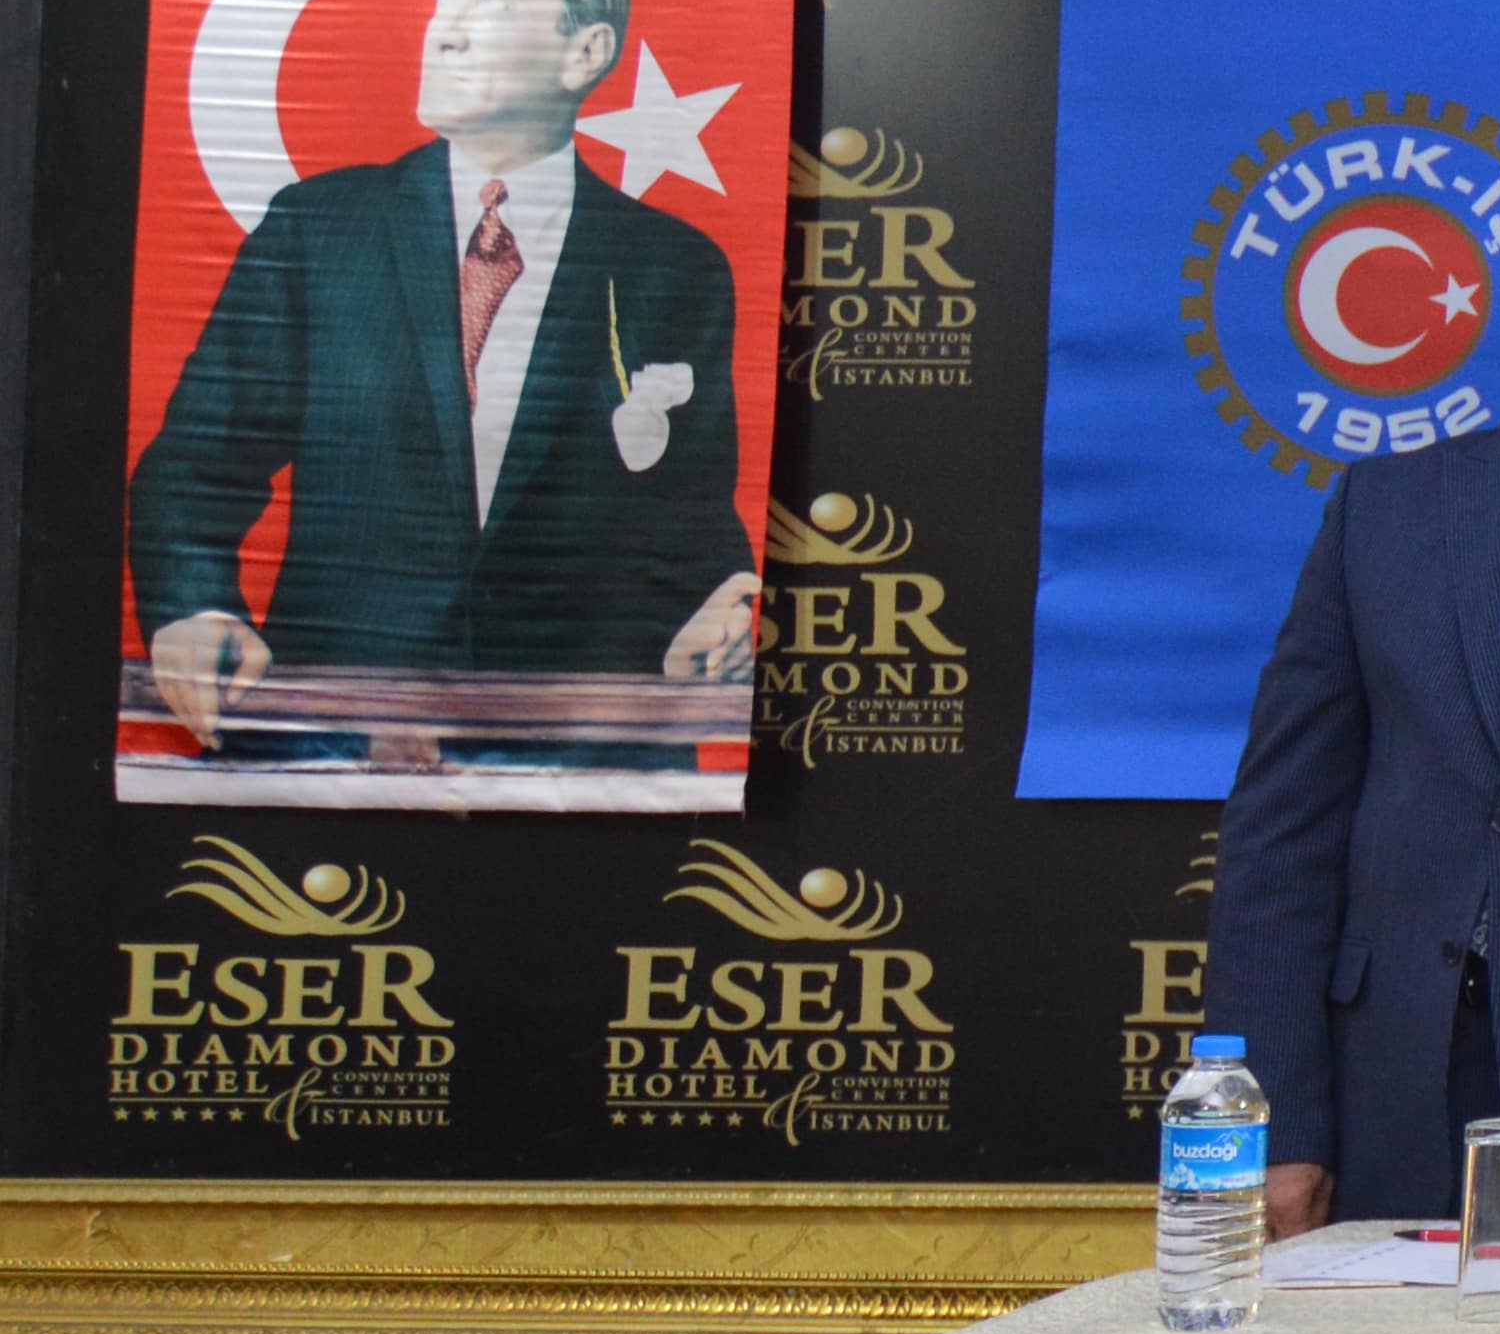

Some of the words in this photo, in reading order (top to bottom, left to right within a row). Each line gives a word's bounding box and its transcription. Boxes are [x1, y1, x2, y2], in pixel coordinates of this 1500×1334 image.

[788, 206, 976, 289] ER
[780, 294, 977, 328] MOND
[853, 331, 973, 344] CONVENTION
[853, 345, 972, 356] CENTER
[1297, 386, 1491, 453] 1952
[759, 572, 967, 655] ER
[759, 661, 969, 696] MOND
[847, 699, 964, 711] CONVENTION
[847, 713, 963, 724] CENTER
[111, 943, 455, 1028] ESER
[608, 947, 954, 1032] ESER
[108, 1033, 455, 1067] DIAMOND
[605, 1037, 955, 1072] DIAMOND
[111, 1070, 269, 1094] HOTEL
[332, 1071, 450, 1083] CONVENTION
[332, 1085, 449, 1096] CENTER
[607, 1074, 767, 1098] HOTEL
[832, 1077, 950, 1088] CONVENTION
[832, 1089, 949, 1101] CENTER
